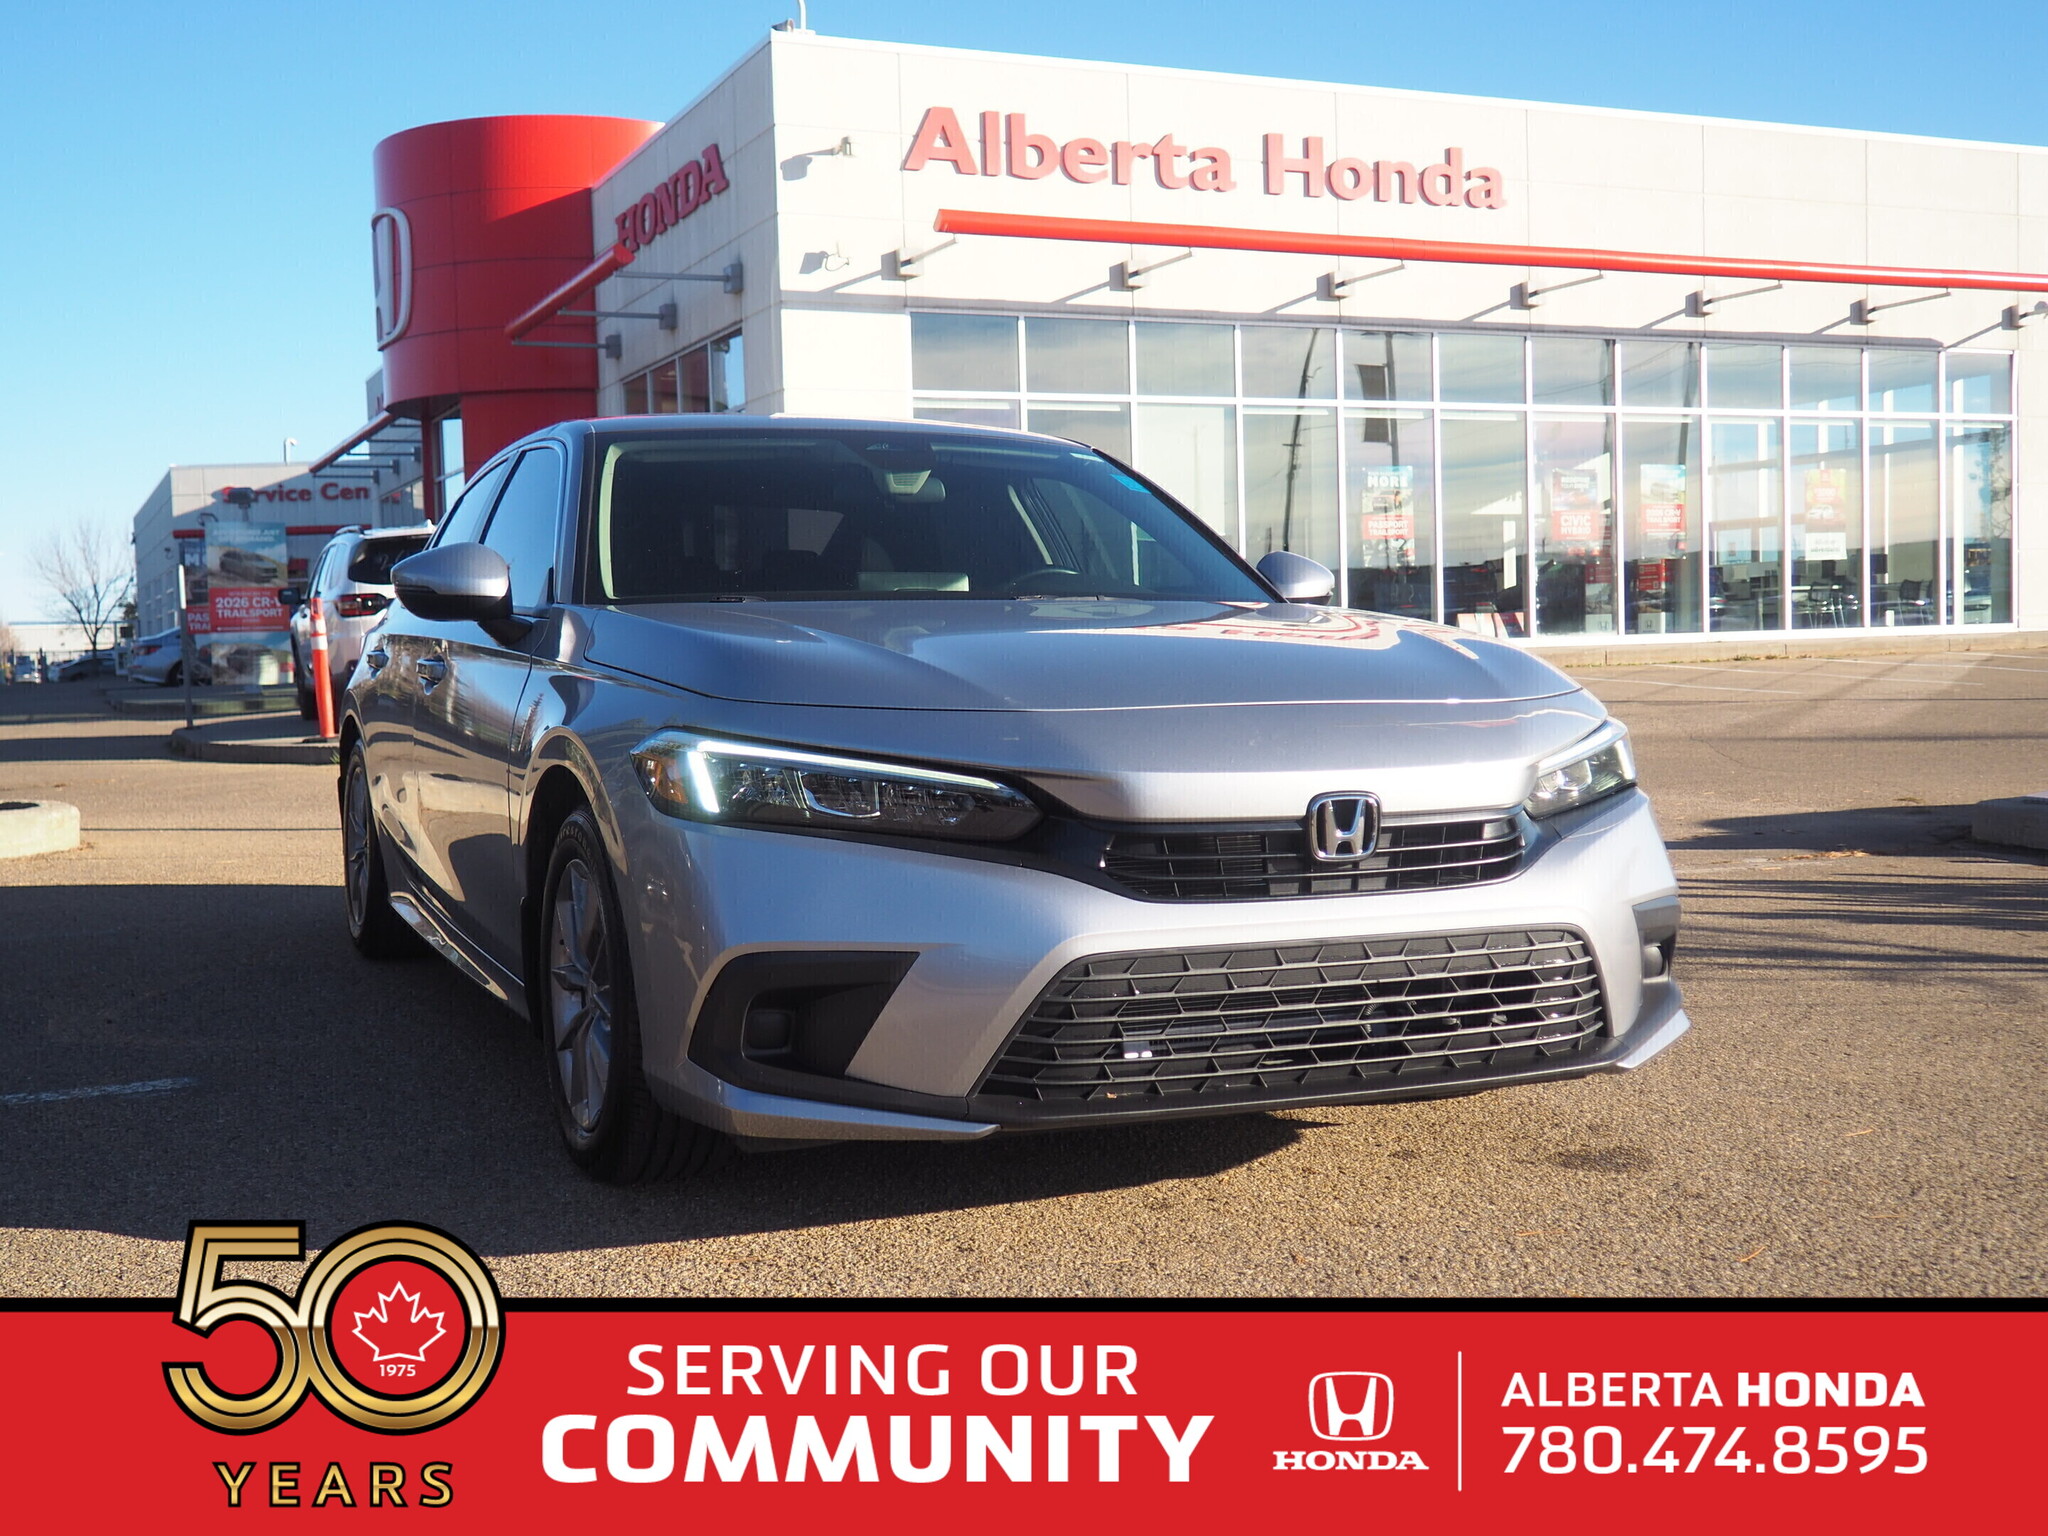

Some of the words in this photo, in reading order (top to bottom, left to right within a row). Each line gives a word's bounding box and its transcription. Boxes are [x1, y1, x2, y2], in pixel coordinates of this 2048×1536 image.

[903, 106, 1235, 193] Alberta
[1261, 132, 1507, 209] Honda
[615, 143, 730, 253] HONDA
[1367, 475, 1408, 488] MORE
[1367, 520, 1409, 530] PASSPORT
[1560, 515, 1592, 527] CIVIC
[1560, 527, 1592, 535] HYBRID
[216, 597, 248, 608] 2026
[217, 608, 283, 618] TRAILSPORT
